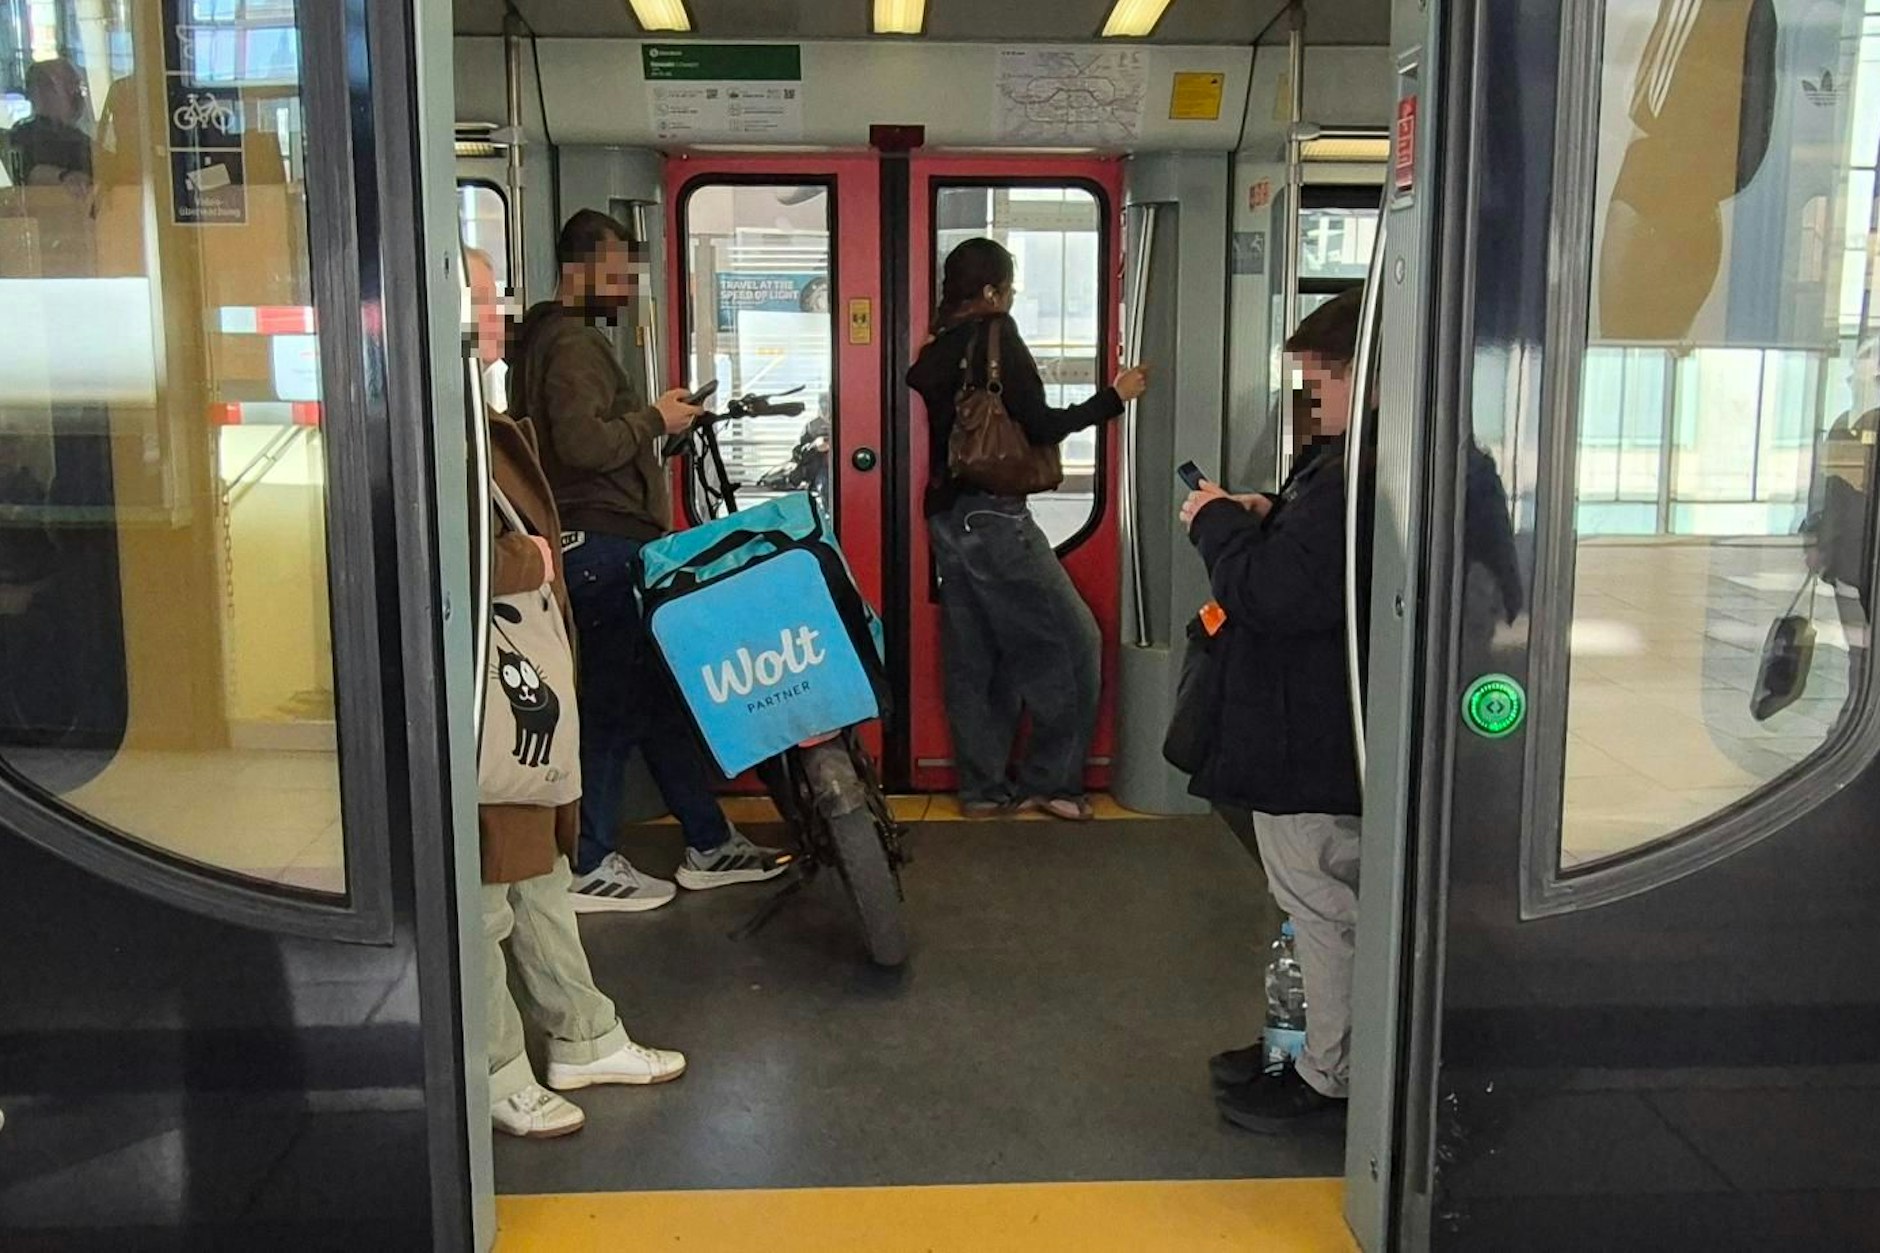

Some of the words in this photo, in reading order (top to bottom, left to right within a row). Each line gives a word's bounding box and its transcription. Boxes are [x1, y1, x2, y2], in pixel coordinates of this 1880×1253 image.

[720, 280, 758, 290] TRAVEL
[760, 280, 772, 290] AT
[720, 290, 754, 300] SPEED
[754, 290, 768, 300] OF
[769, 290, 800, 300] LIGHT
[702, 625, 826, 704] Wolt
[747, 681, 811, 713] PARTNER
